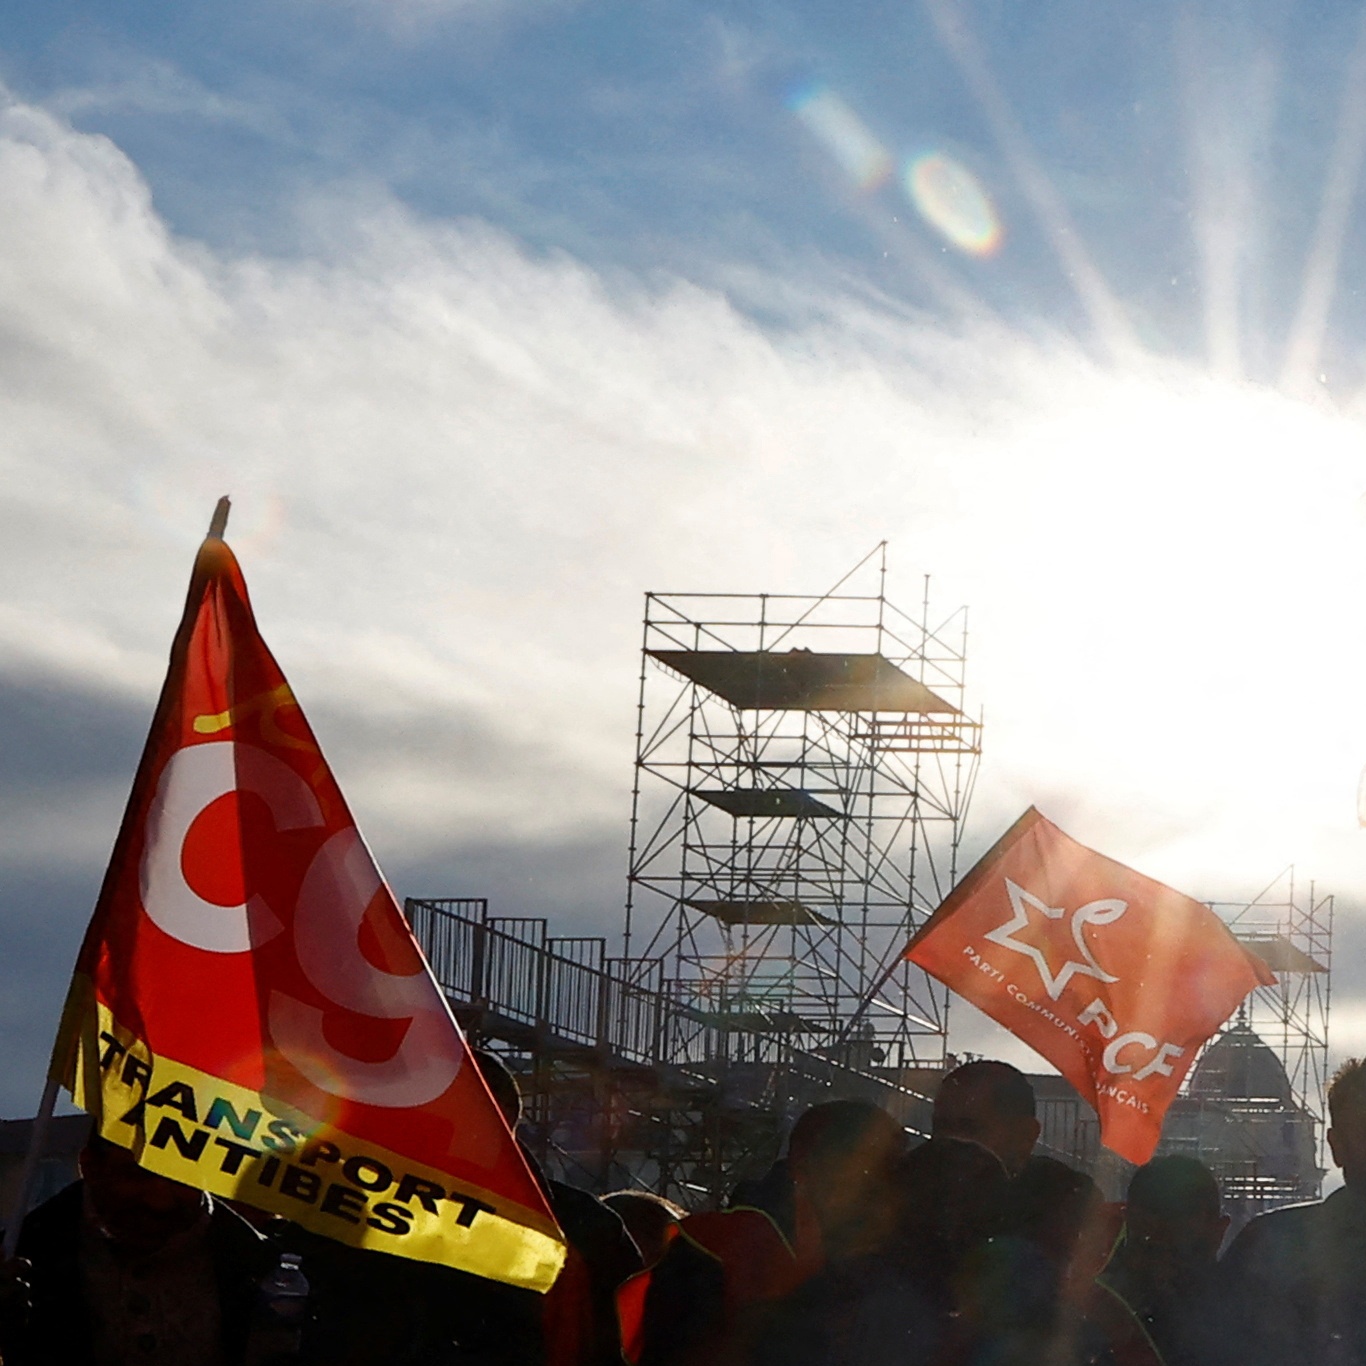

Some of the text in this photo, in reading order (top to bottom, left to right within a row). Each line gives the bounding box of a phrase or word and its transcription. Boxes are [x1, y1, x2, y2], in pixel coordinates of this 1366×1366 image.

[963, 946, 1150, 1115] PARTI COMMUNI ANÇAIS
[1076, 997, 1184, 1081] PCF
[100, 1031, 497, 1229] TRANSPORT
[119, 1104, 415, 1237] ANTIBES
